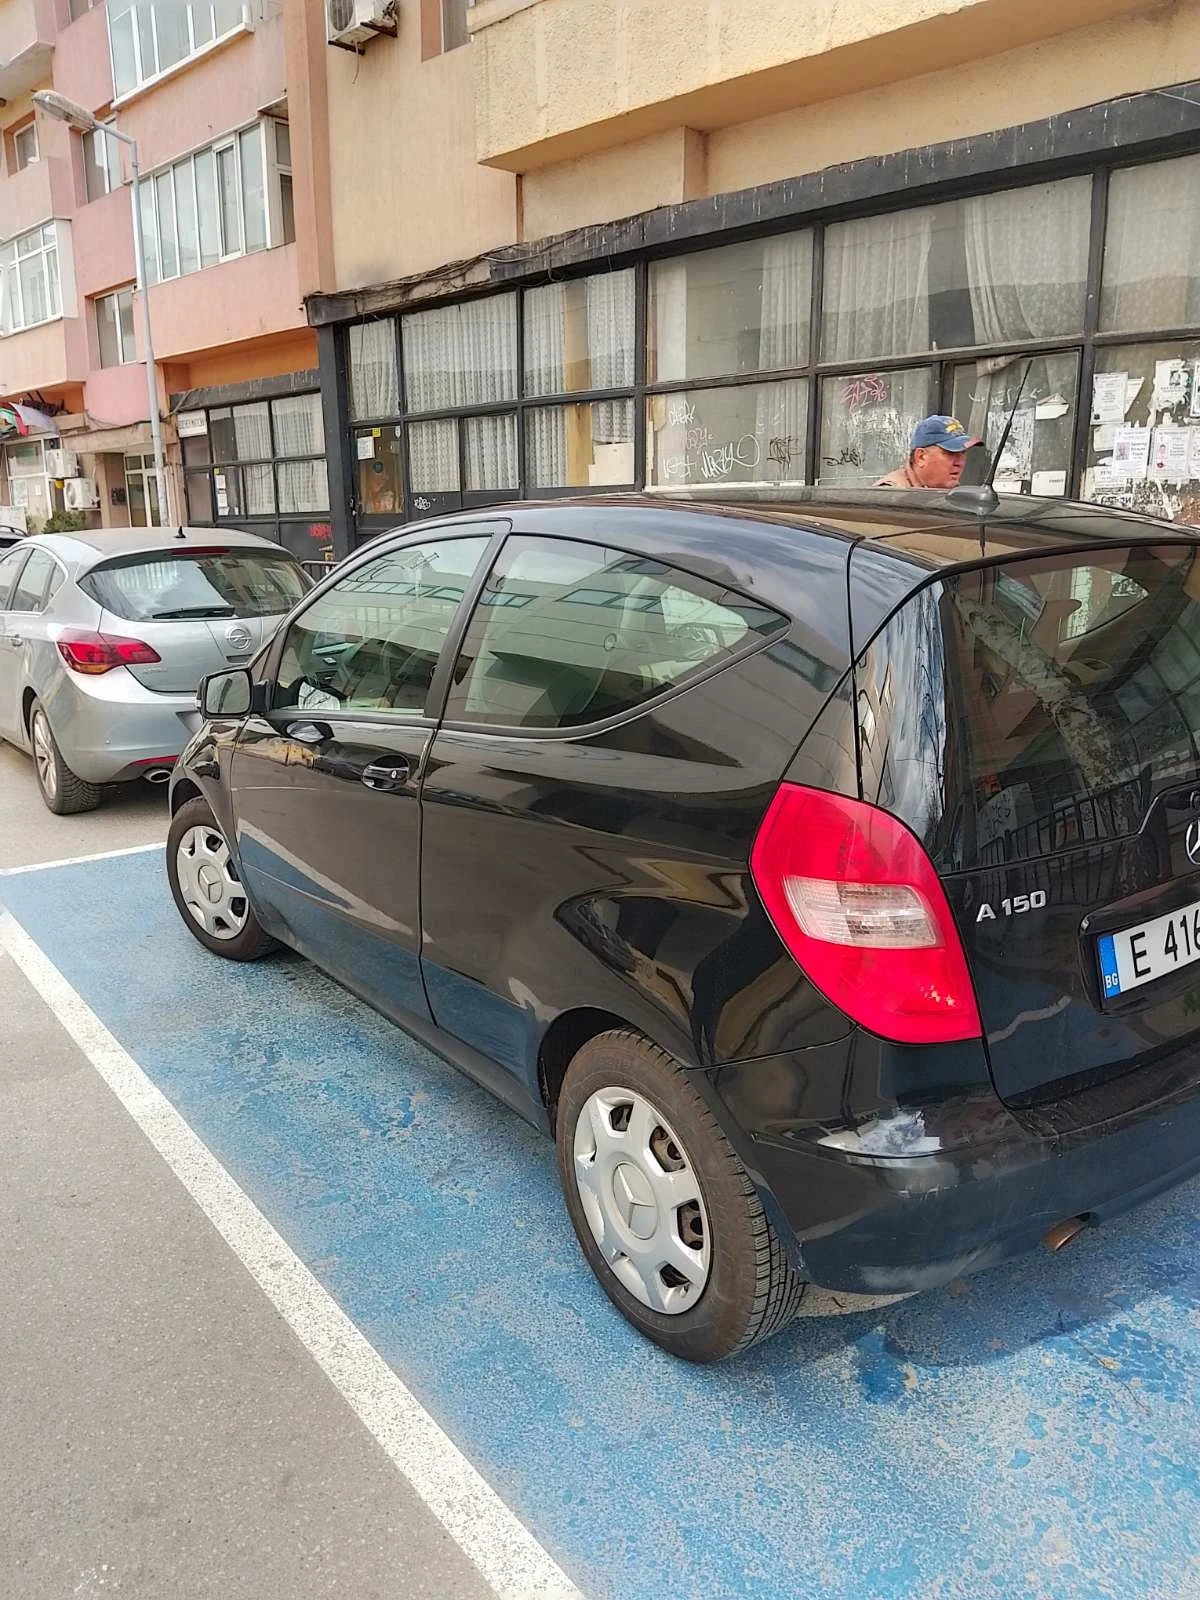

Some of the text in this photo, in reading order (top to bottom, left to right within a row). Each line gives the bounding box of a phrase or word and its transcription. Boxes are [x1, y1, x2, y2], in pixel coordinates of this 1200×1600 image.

[976, 890, 1046, 923] A 150
[1129, 931, 1152, 979] E
[1105, 972, 1119, 989] BG
